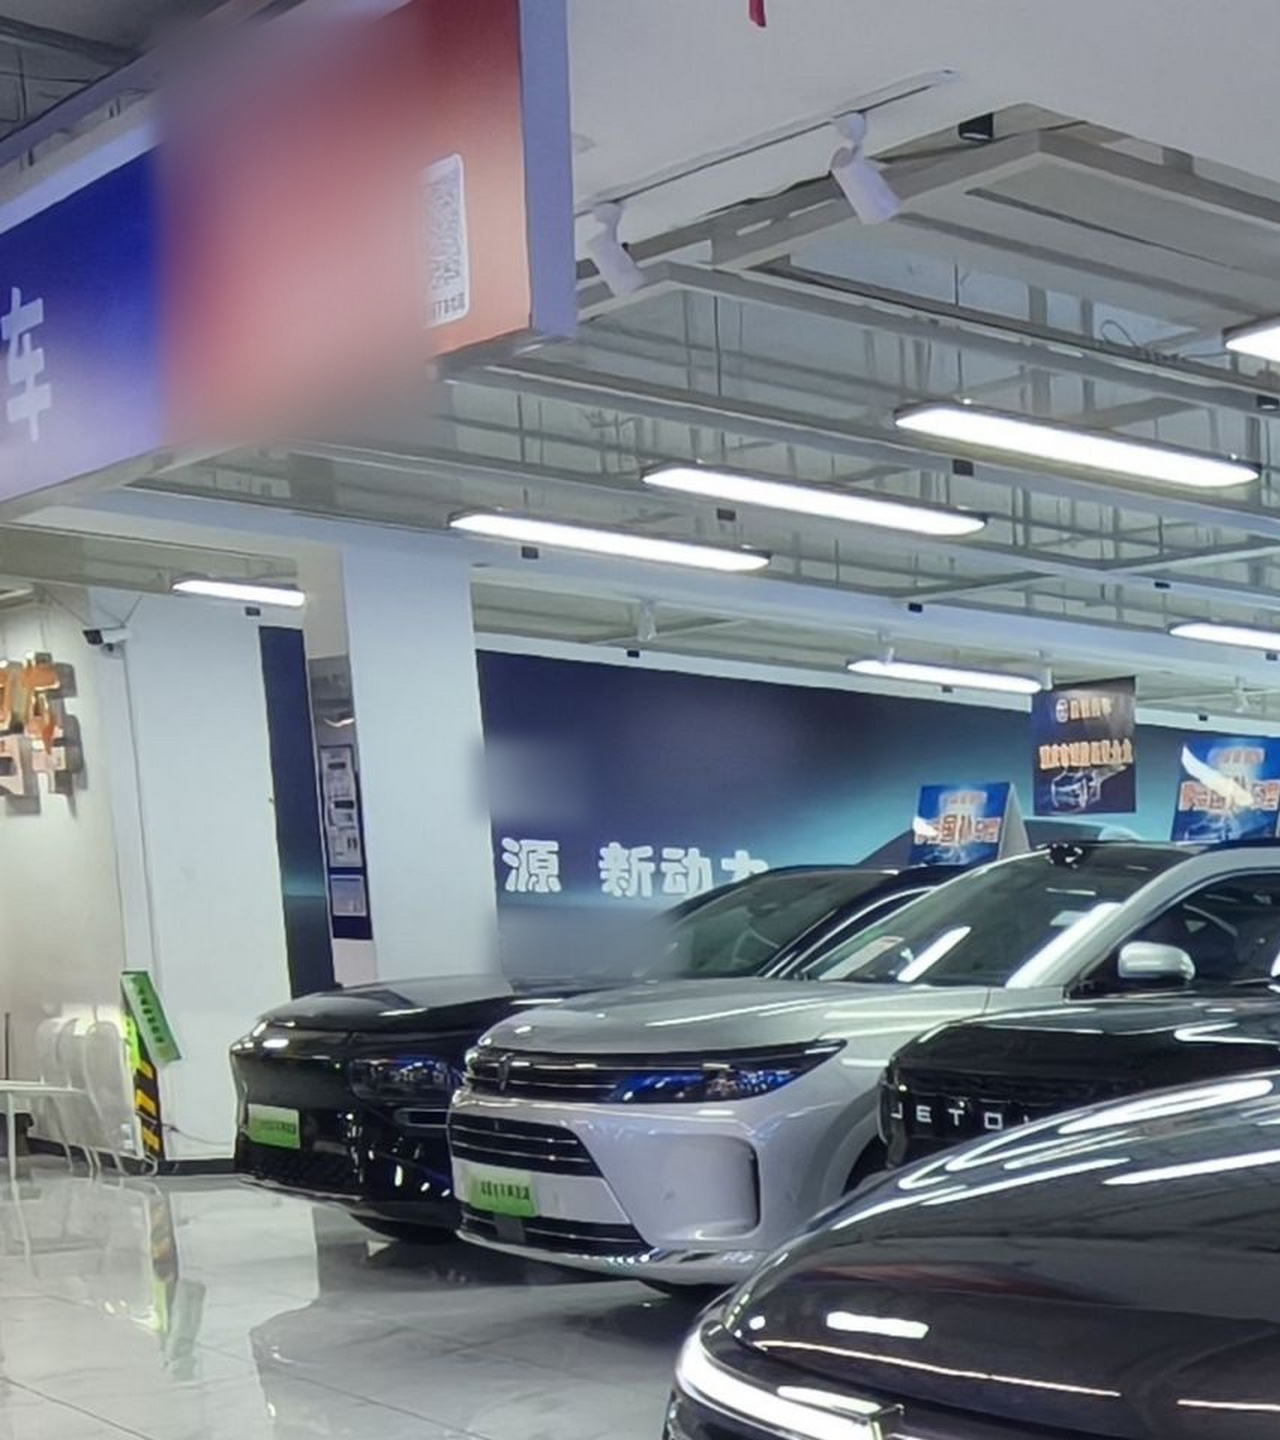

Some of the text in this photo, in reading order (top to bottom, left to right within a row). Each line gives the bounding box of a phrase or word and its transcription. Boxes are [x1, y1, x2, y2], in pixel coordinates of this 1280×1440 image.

[1, 286, 51, 442] 车
[501, 837, 562, 893] 源
[890, 1102, 1030, 1131] JETO
